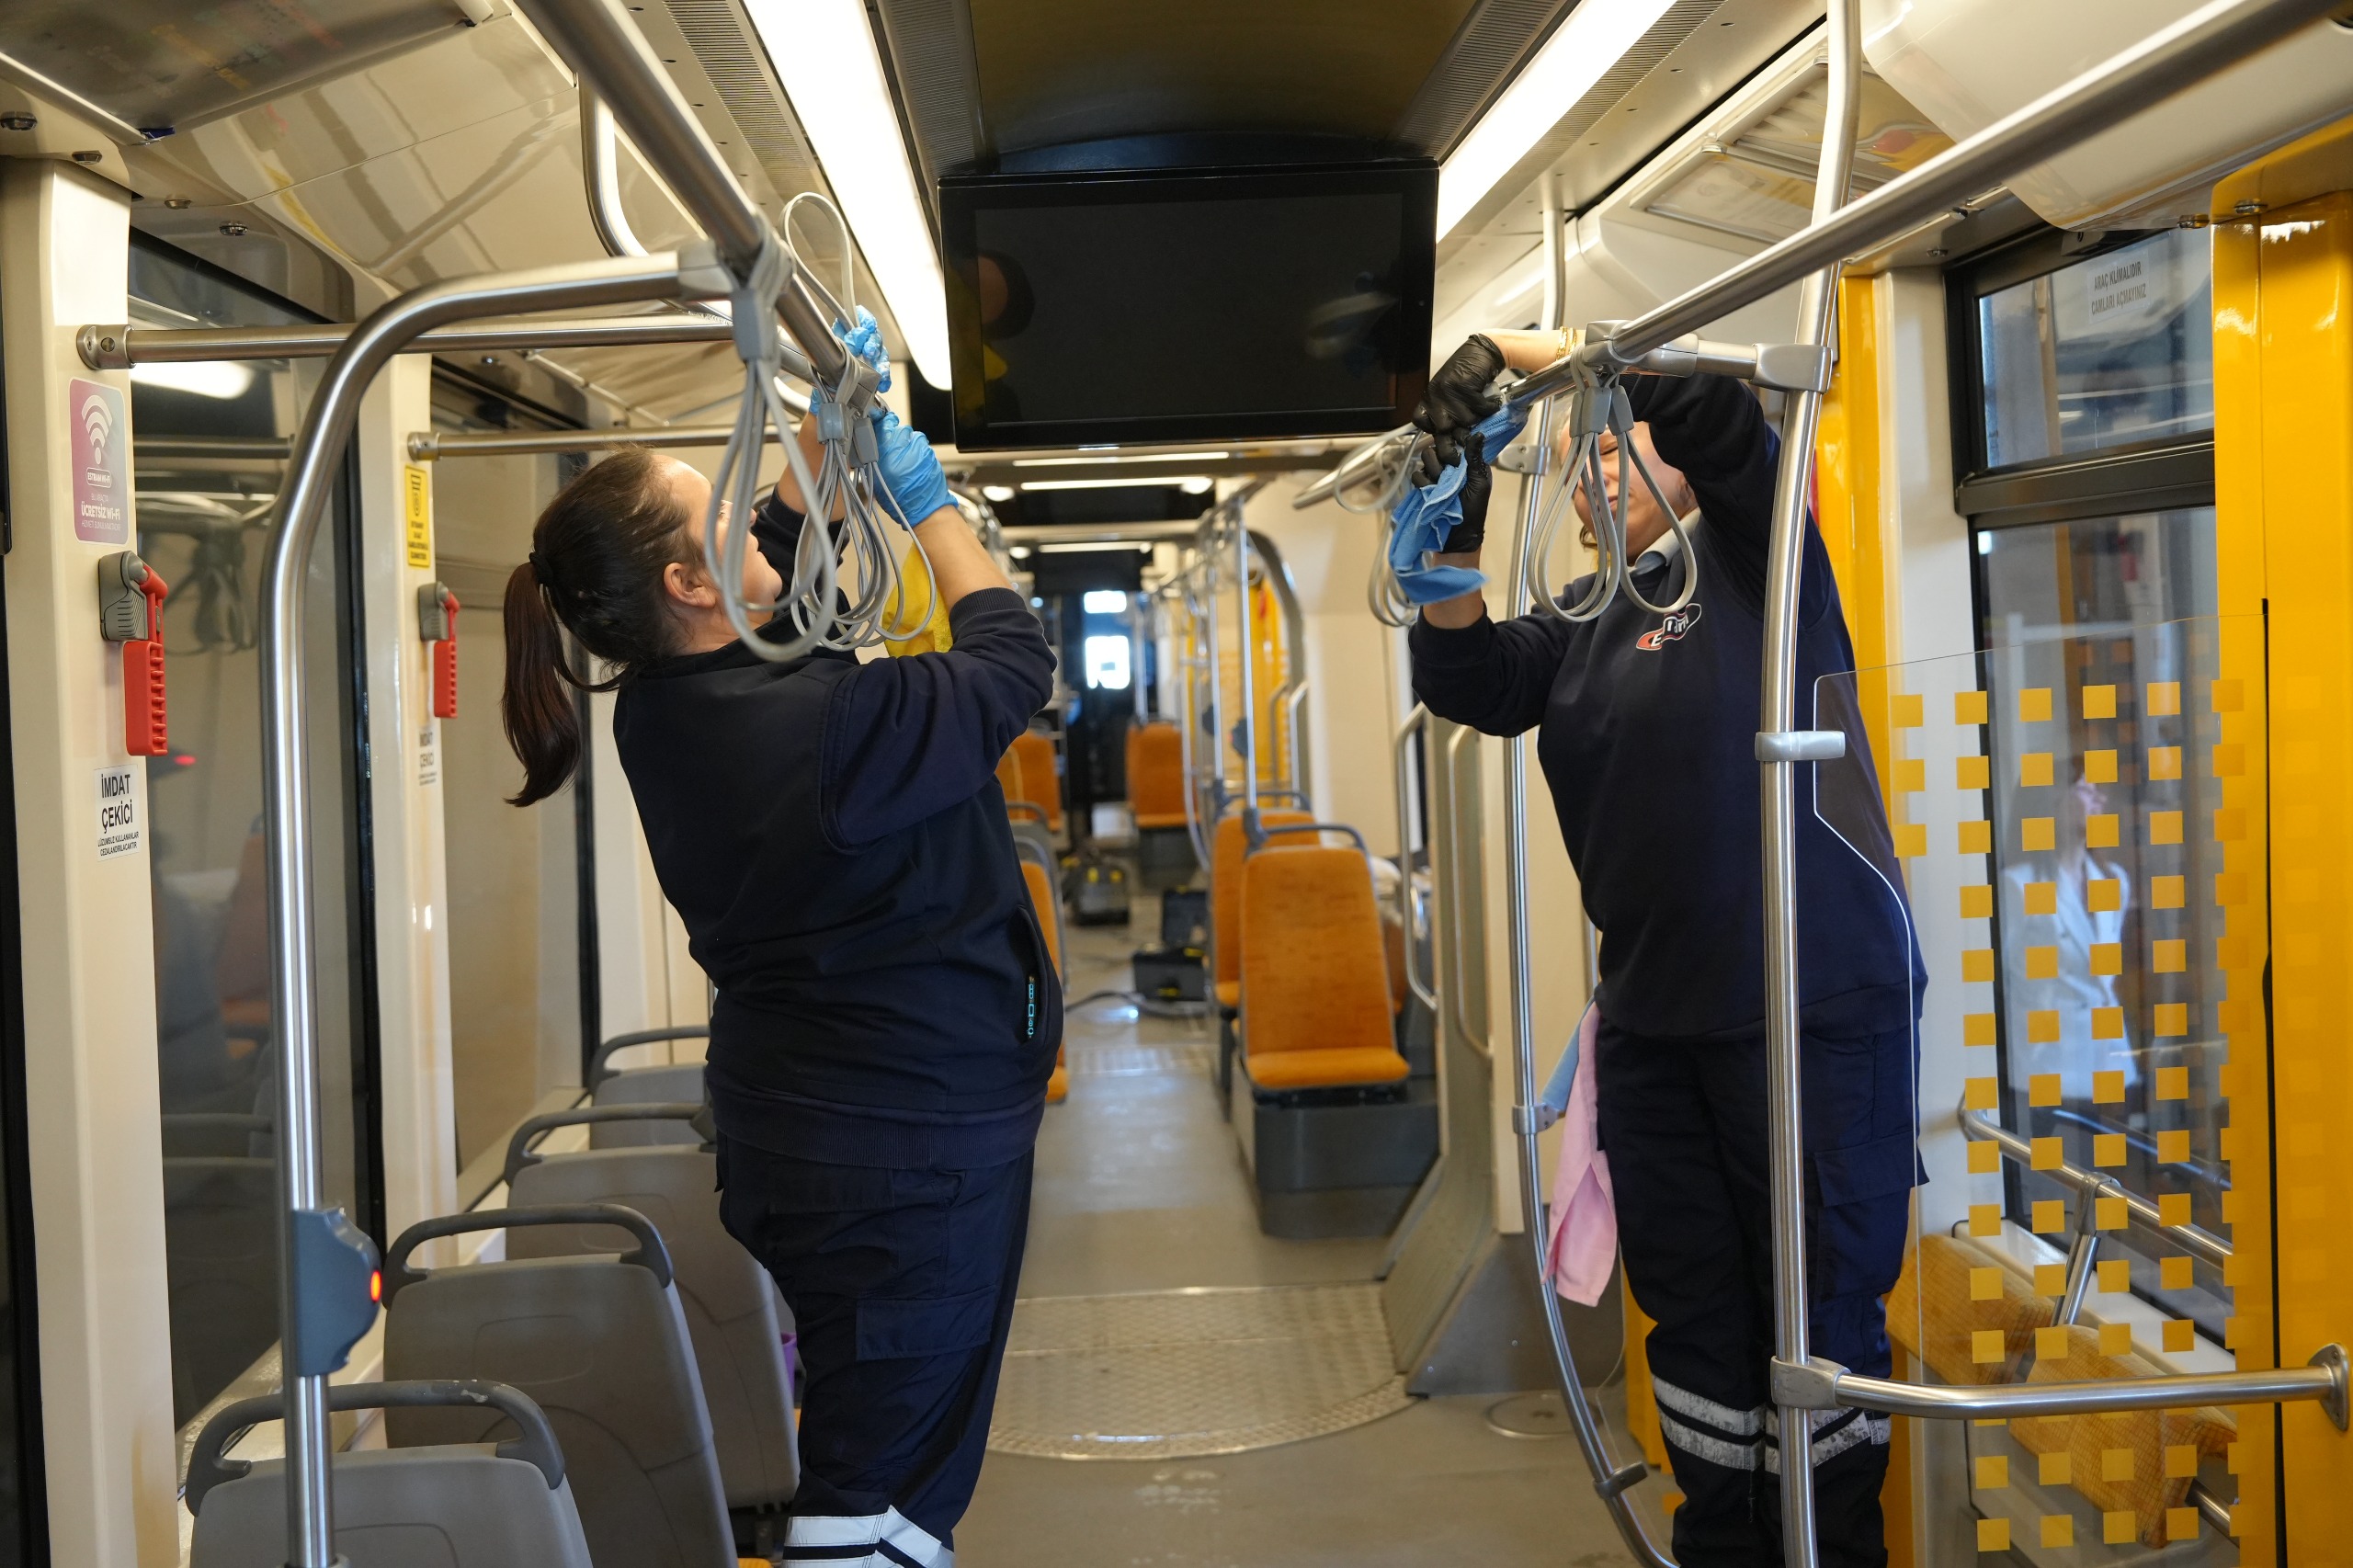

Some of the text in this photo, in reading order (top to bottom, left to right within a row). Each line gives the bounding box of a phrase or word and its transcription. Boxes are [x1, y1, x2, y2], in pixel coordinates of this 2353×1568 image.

[2095, 273, 2109, 291] ARAÇ
[81, 501, 107, 519] ÜCRETSİZ
[101, 774, 131, 798] İMDAT
[101, 799, 133, 834] ÇEKİCİ
